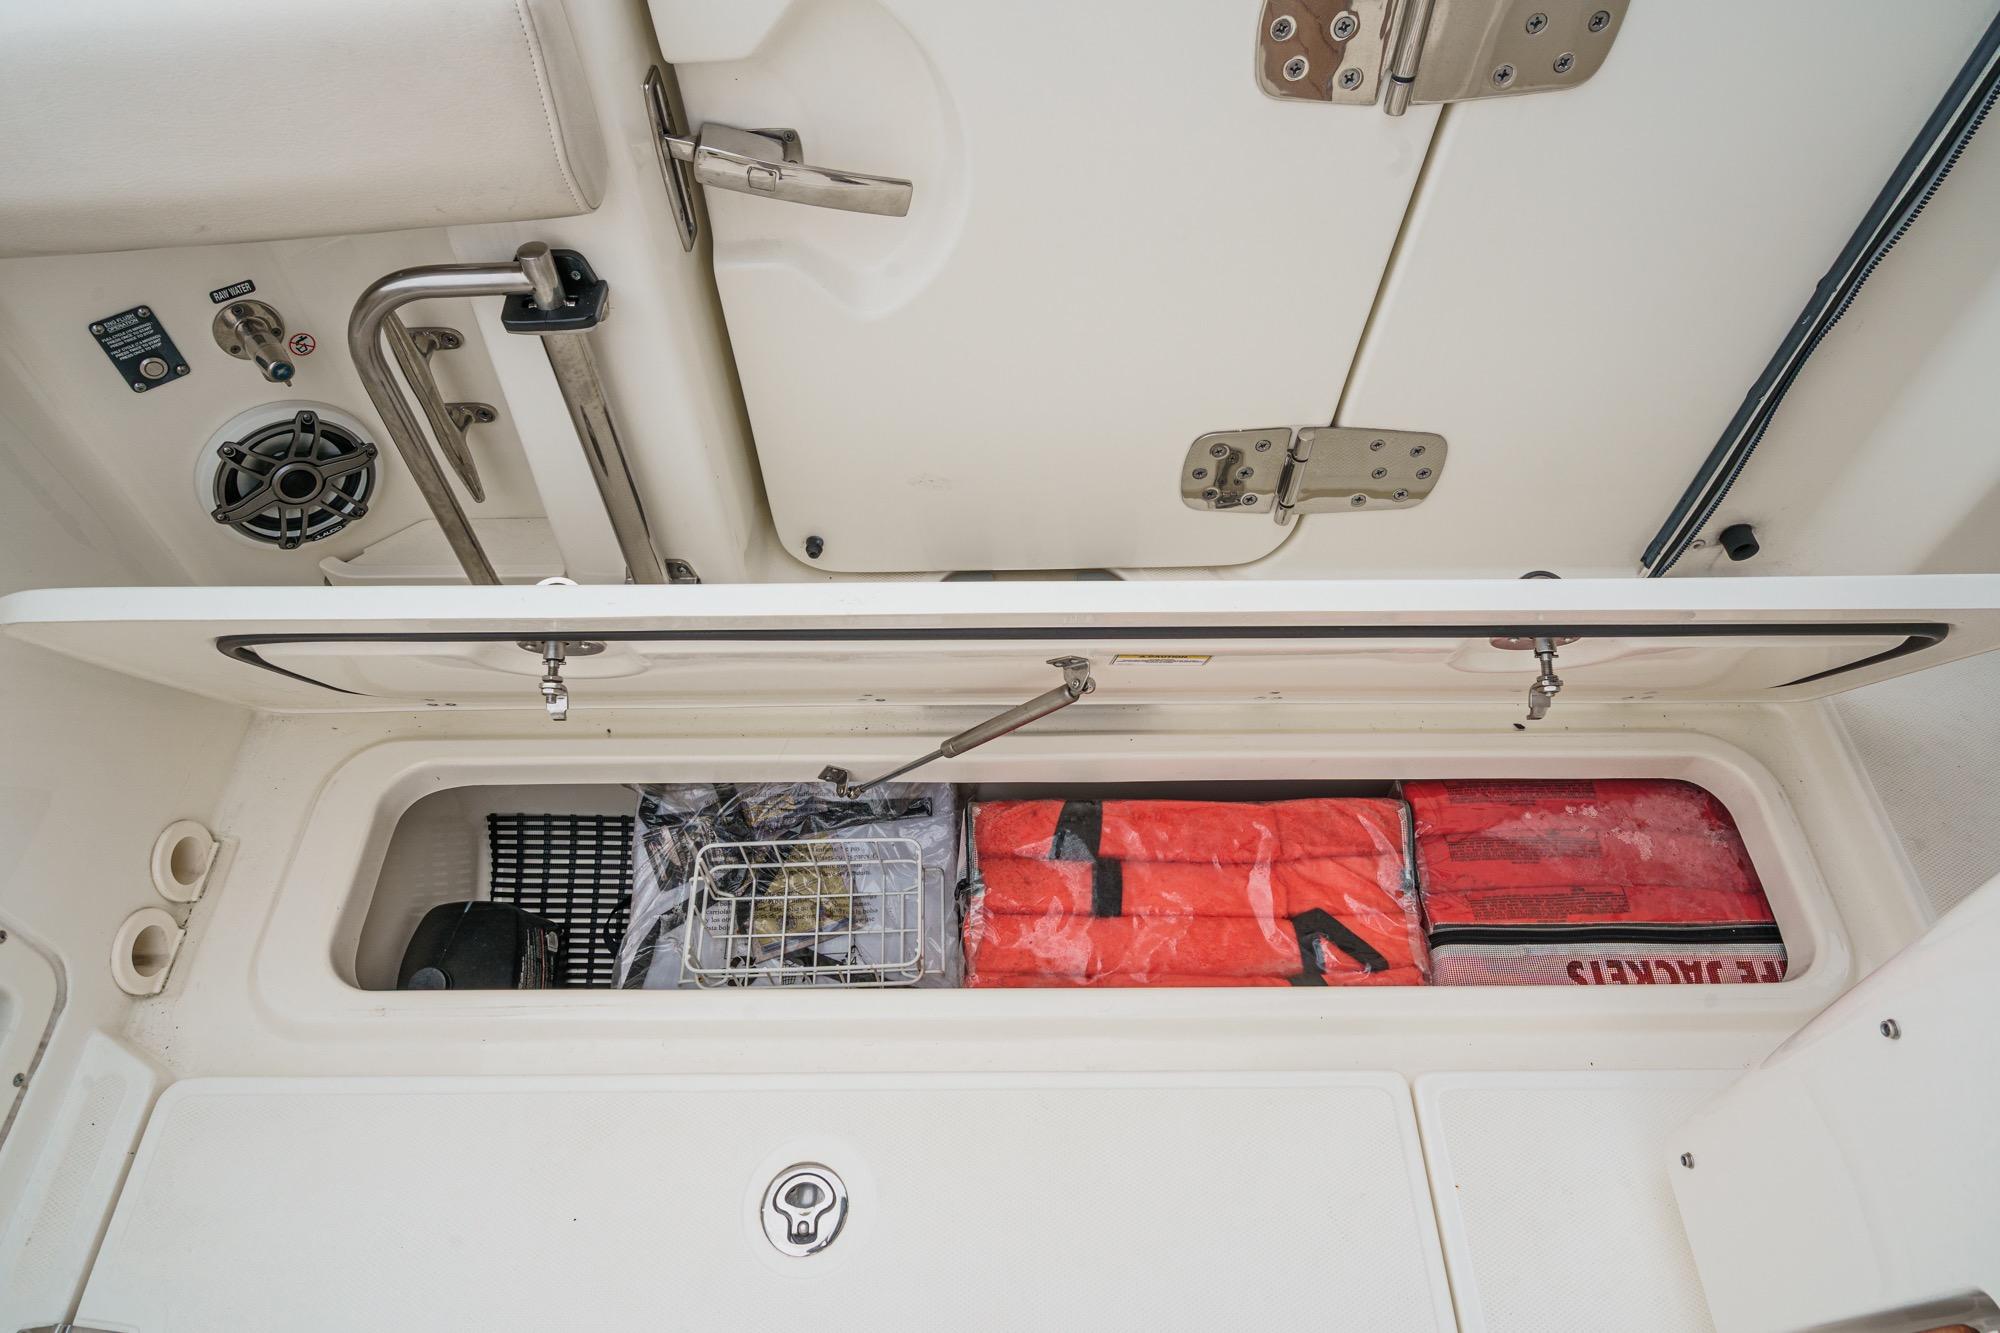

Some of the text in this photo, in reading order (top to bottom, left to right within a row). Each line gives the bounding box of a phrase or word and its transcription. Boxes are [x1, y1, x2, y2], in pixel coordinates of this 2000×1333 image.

[213, 282, 252, 302] RAW WATER
[104, 313, 136, 329] ENG FLUSH
[106, 319, 139, 333] OPERATION
[106, 337, 121, 345] PRESS
[120, 333, 133, 341] ONCE
[139, 325, 152, 333] START
[110, 341, 124, 349] PRESS
[123, 336, 137, 344] TWICE
[142, 329, 154, 337] STOP
[111, 331, 126, 339] CYCLE
[115, 350, 130, 358] PRESS
[148, 337, 162, 346] START
[119, 353, 134, 361] PRESS
[133, 348, 146, 356] ONCE
[151, 341, 163, 349] STOP
[121, 344, 135, 352] CYCLE
[322, 525, 343, 537] AUDIO
